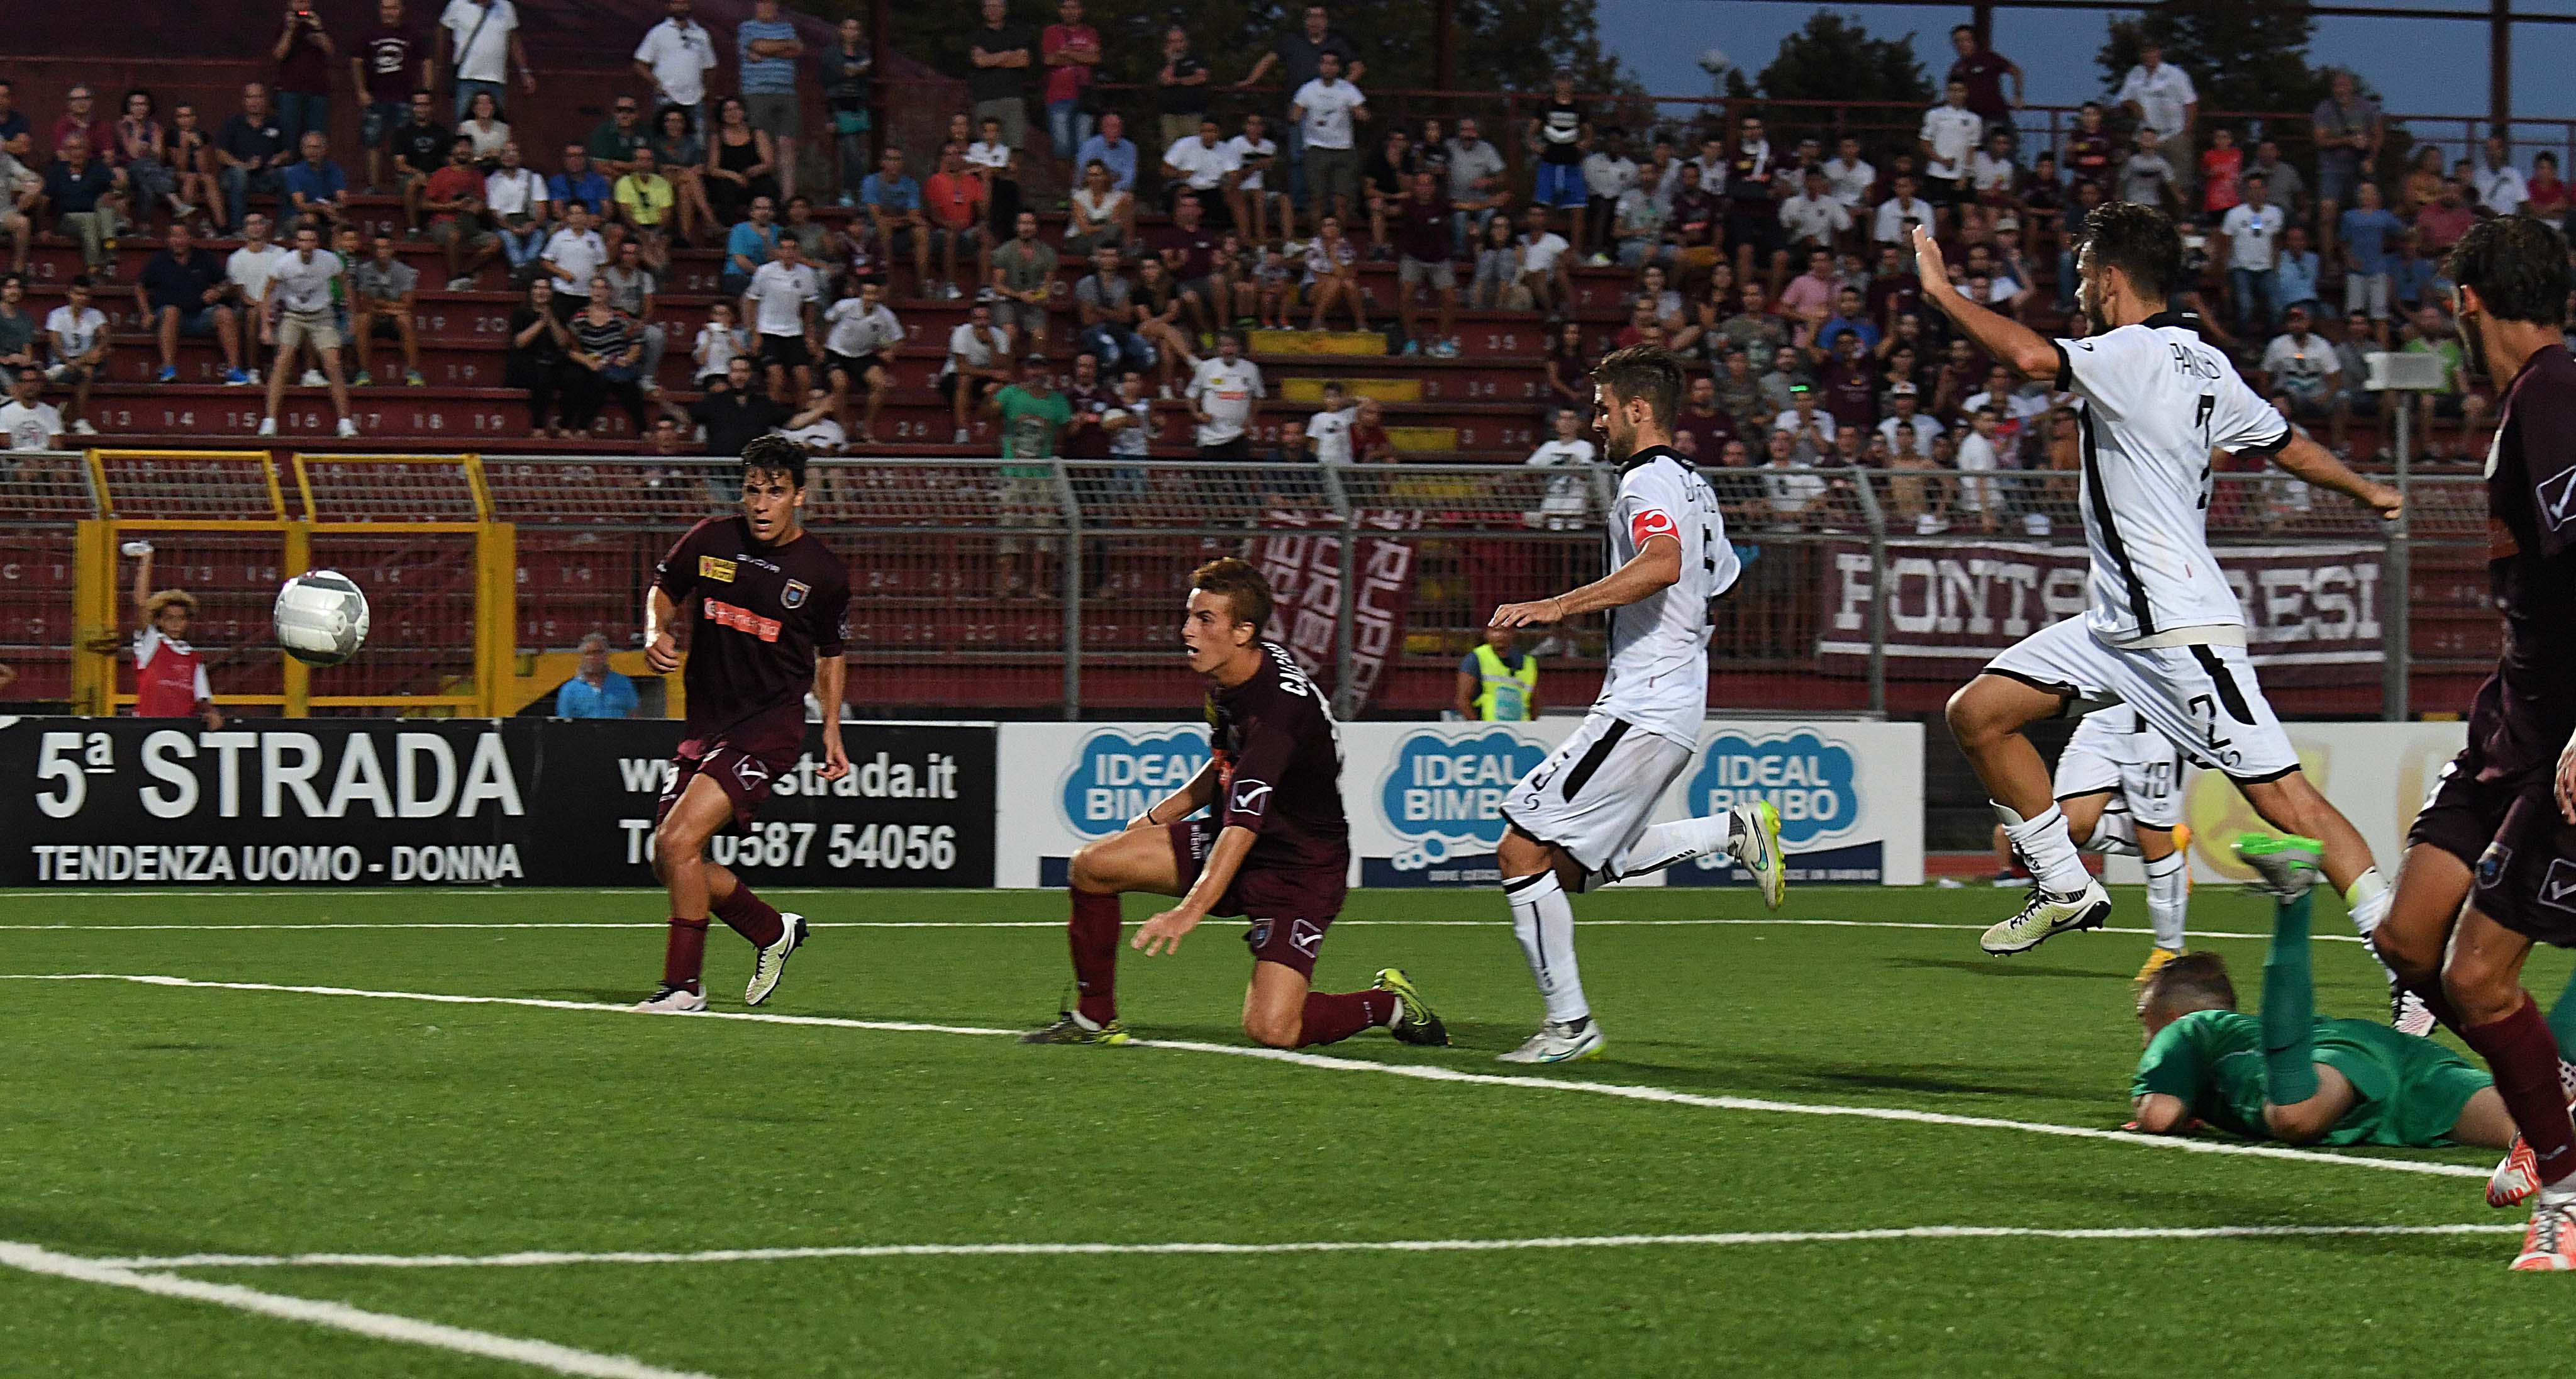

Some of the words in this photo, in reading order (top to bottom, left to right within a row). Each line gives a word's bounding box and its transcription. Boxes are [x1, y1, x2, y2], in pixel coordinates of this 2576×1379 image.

[138, 730, 525, 818] STRADA
[1413, 754, 1523, 786] IDEAL
[1718, 755, 1830, 786] IDEAL
[32, 845, 236, 881] TENDENZA
[243, 845, 360, 881] UOMO
[391, 844, 525, 881] DONNA
[711, 822, 816, 867] 0587
[827, 823, 957, 870] 54056
